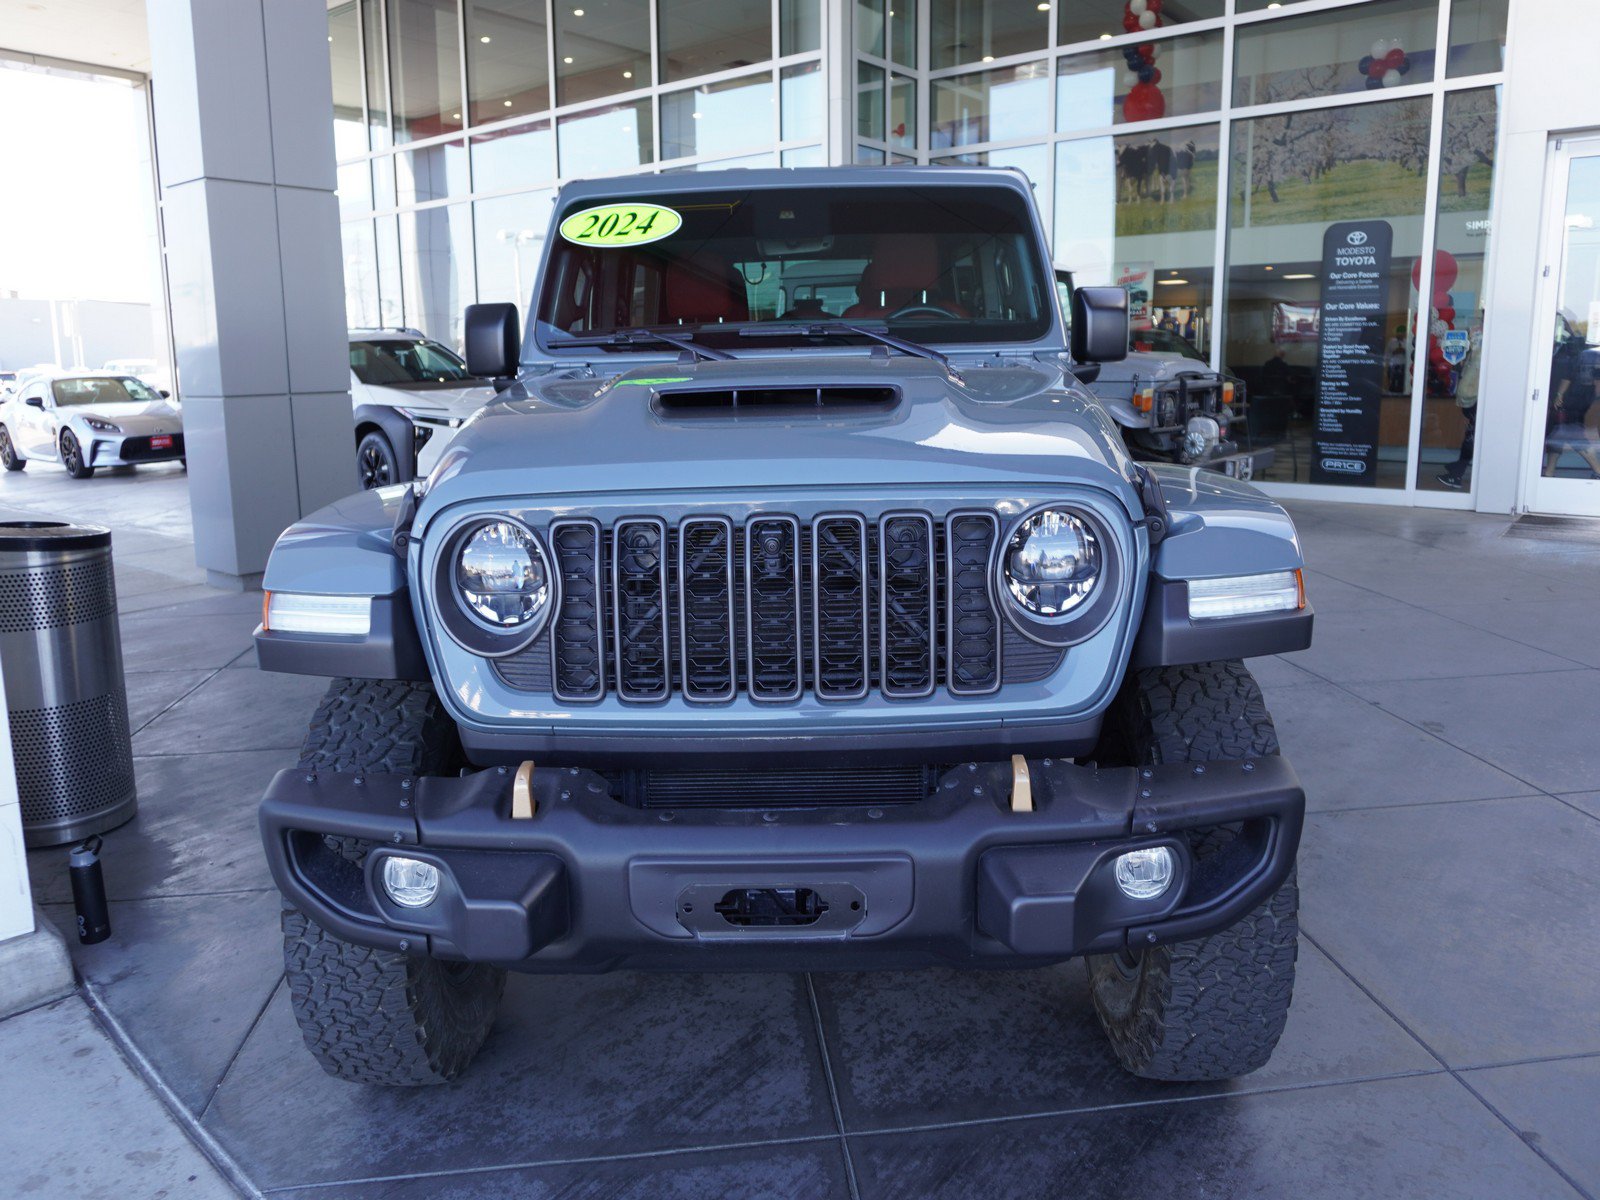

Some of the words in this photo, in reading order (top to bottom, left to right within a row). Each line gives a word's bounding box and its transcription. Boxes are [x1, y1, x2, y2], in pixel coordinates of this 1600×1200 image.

[576, 210, 660, 239] 2024
[1336, 246, 1376, 256] MODESTO
[1335, 256, 1376, 266] TOYOTA
[1339, 302, 1355, 310] Core
